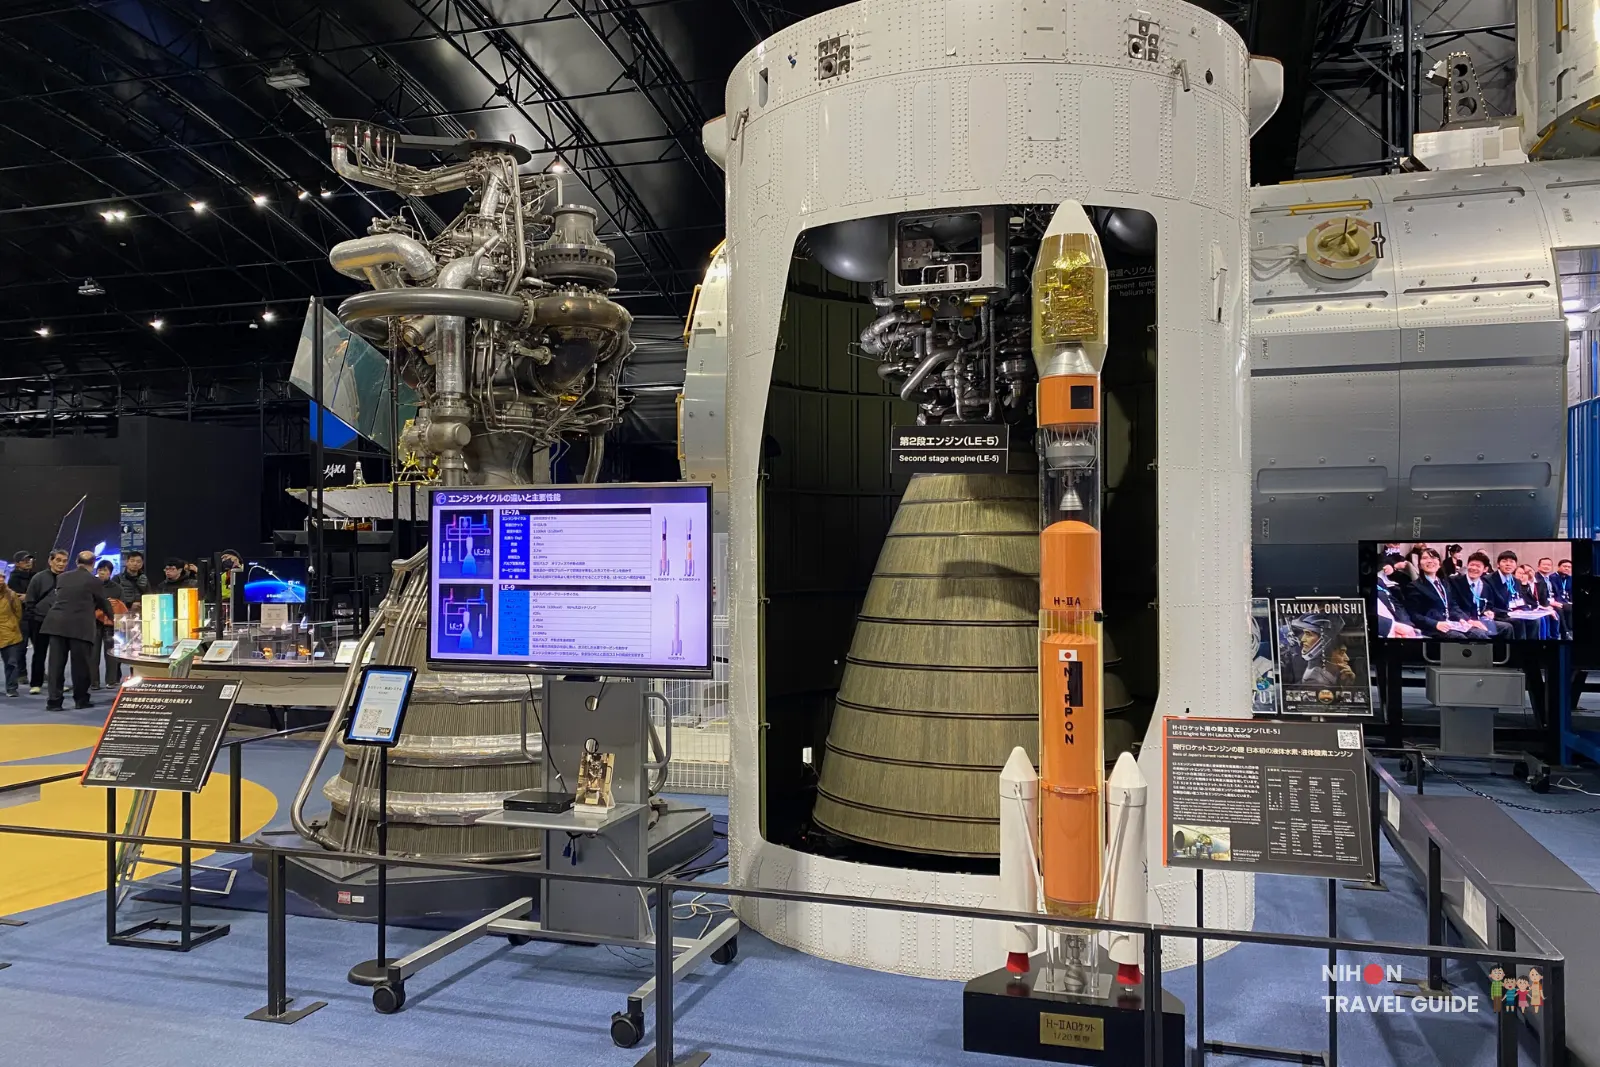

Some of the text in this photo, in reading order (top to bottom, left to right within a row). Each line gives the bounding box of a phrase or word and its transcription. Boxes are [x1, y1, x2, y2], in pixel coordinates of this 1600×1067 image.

[1109, 282, 1135, 290] mbient
[1119, 289, 1144, 297] helium
[899, 436, 1000, 447] 第2段エンジン(LE-5)
[928, 455, 949, 464] stage
[950, 455, 976, 464] engine
[976, 455, 1000, 463] (LE-5)
[322, 463, 346, 480] JAXA
[448, 493, 561, 503] エンジンサイクルの違いと主要性能
[1280, 603, 1362, 614] TAKUYA ONISHI
[1063, 667, 1075, 745] NIPPON
